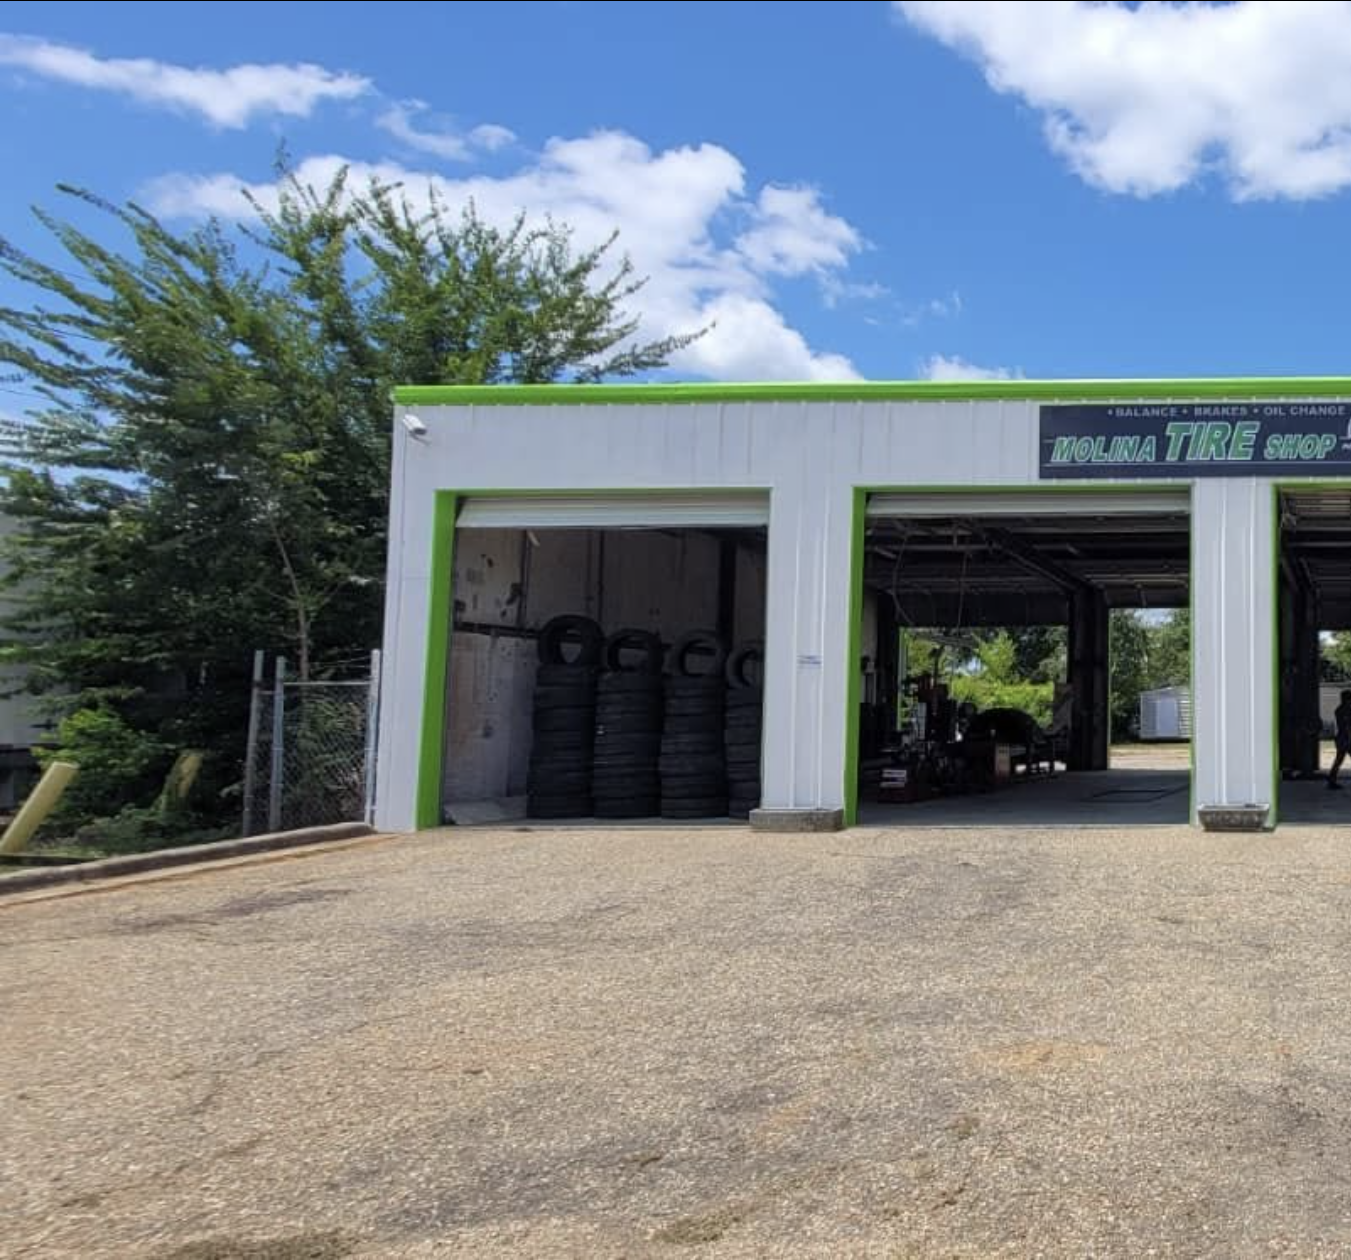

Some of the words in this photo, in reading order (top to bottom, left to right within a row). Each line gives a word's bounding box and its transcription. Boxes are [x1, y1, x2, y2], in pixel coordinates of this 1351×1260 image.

[1115, 407, 1177, 417] BALANCE
[1194, 406, 1248, 416] BRAKES
[1263, 406, 1287, 416] OIL
[1290, 405, 1346, 416] CHANGE
[1050, 436, 1156, 462] MOLINA
[1165, 421, 1262, 461] TIRE
[1264, 434, 1337, 460] SHOP
